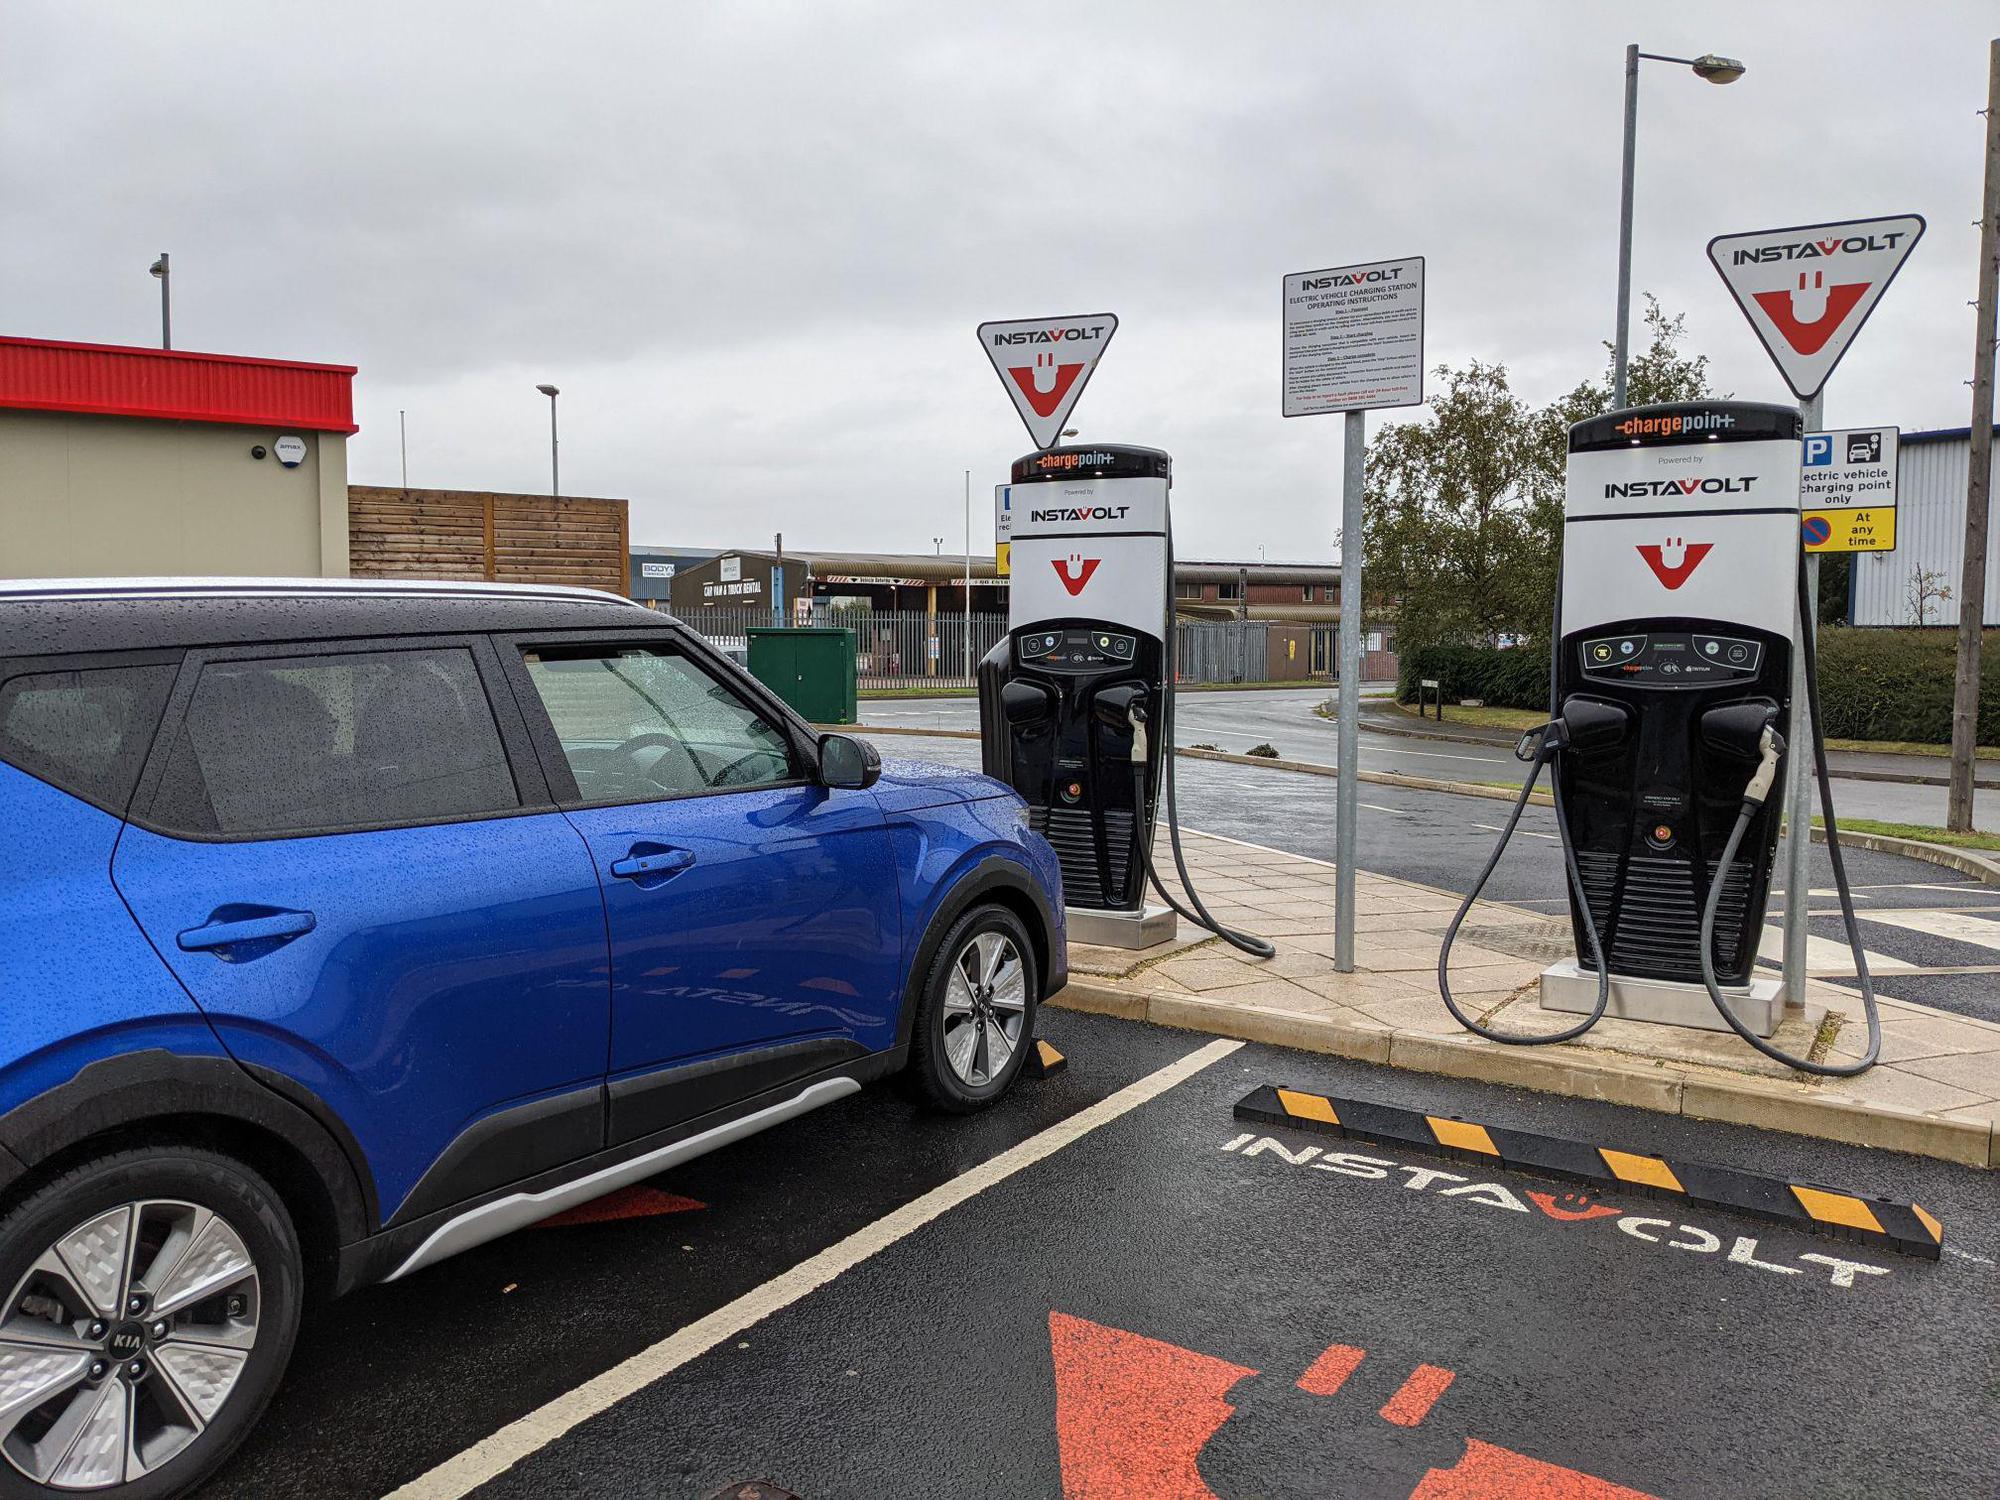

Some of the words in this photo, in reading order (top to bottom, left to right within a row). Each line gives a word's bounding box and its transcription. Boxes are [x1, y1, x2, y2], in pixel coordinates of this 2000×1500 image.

[1733, 232, 1904, 266] INSTAVOLT
[1302, 268, 1403, 291] INSTAVOLT
[1290, 294, 1318, 304] ELECTRIC
[1320, 291, 1348, 300] VEHICLE
[1350, 287, 1386, 298] CHARGING
[1387, 283, 1417, 292] STATION
[1308, 300, 1346, 310] OPERATING
[1347, 294, 1398, 306] INSTRUCTIONS
[994, 326, 1105, 346] INSTAVOLT
[1807, 439, 1827, 464] P
[1658, 456, 1692, 465] Powered
[1693, 455, 1703, 465] by
[1803, 471, 1839, 482] ectric
[1844, 469, 1888, 479] vehicle
[1064, 488, 1086, 497] Powered
[1087, 488, 1094, 496] by
[1604, 476, 1759, 499] INSTAVOLT
[1801, 482, 1854, 494] charging
[1858, 480, 1892, 491] point
[1825, 494, 1851, 505] only
[1031, 505, 1130, 523] INSTAVOLT
[1856, 513, 1871, 522] At
[1852, 526, 1874, 536] any
[1848, 537, 1876, 546] time
[704, 586, 713, 597] CAR
[714, 585, 722, 596] VAN
[728, 584, 742, 595] TRUCK
[743, 582, 761, 594] RENTAL
[1220, 1134, 1890, 1289] INSTAVOLT
[114, 1334, 140, 1348] KIA
